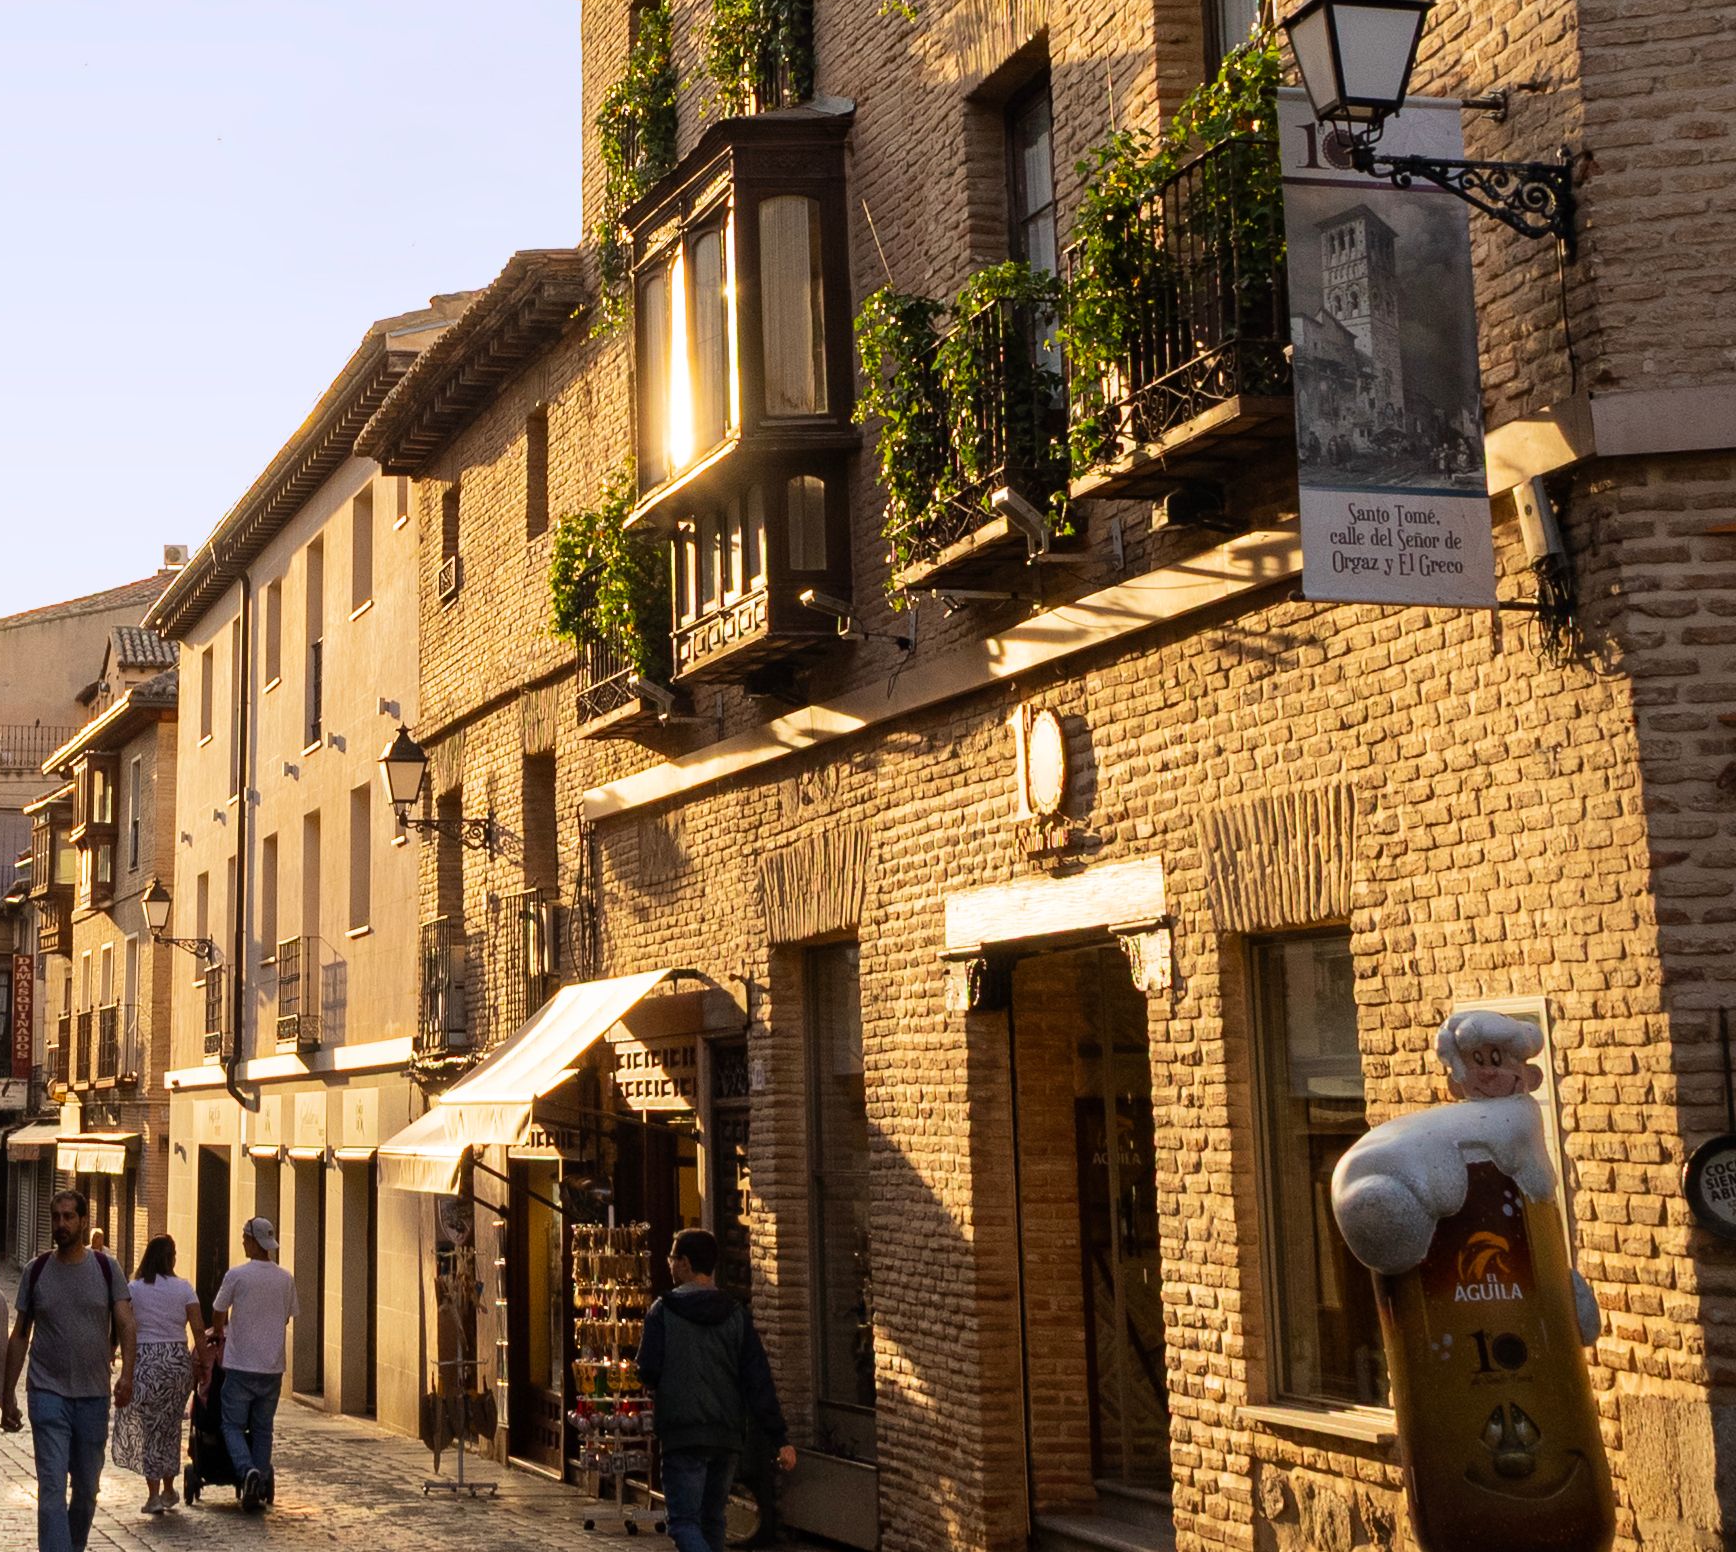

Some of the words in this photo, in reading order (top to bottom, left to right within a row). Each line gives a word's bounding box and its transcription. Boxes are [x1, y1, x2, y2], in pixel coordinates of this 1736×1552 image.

[1348, 502, 1390, 526] Santo
[1330, 526, 1365, 545] calle
[1370, 527, 1393, 547] del
[1397, 529, 1440, 551] Señor
[1445, 530, 1463, 550] de
[1332, 550, 1380, 575] Orgaz
[1384, 558, 1394, 576] y
[1399, 553, 1414, 576] El
[1419, 553, 1463, 577] Greco
[15, 956, 32, 1059] DAMASQUINADOS
[1705, 1159, 1736, 1178] COC
